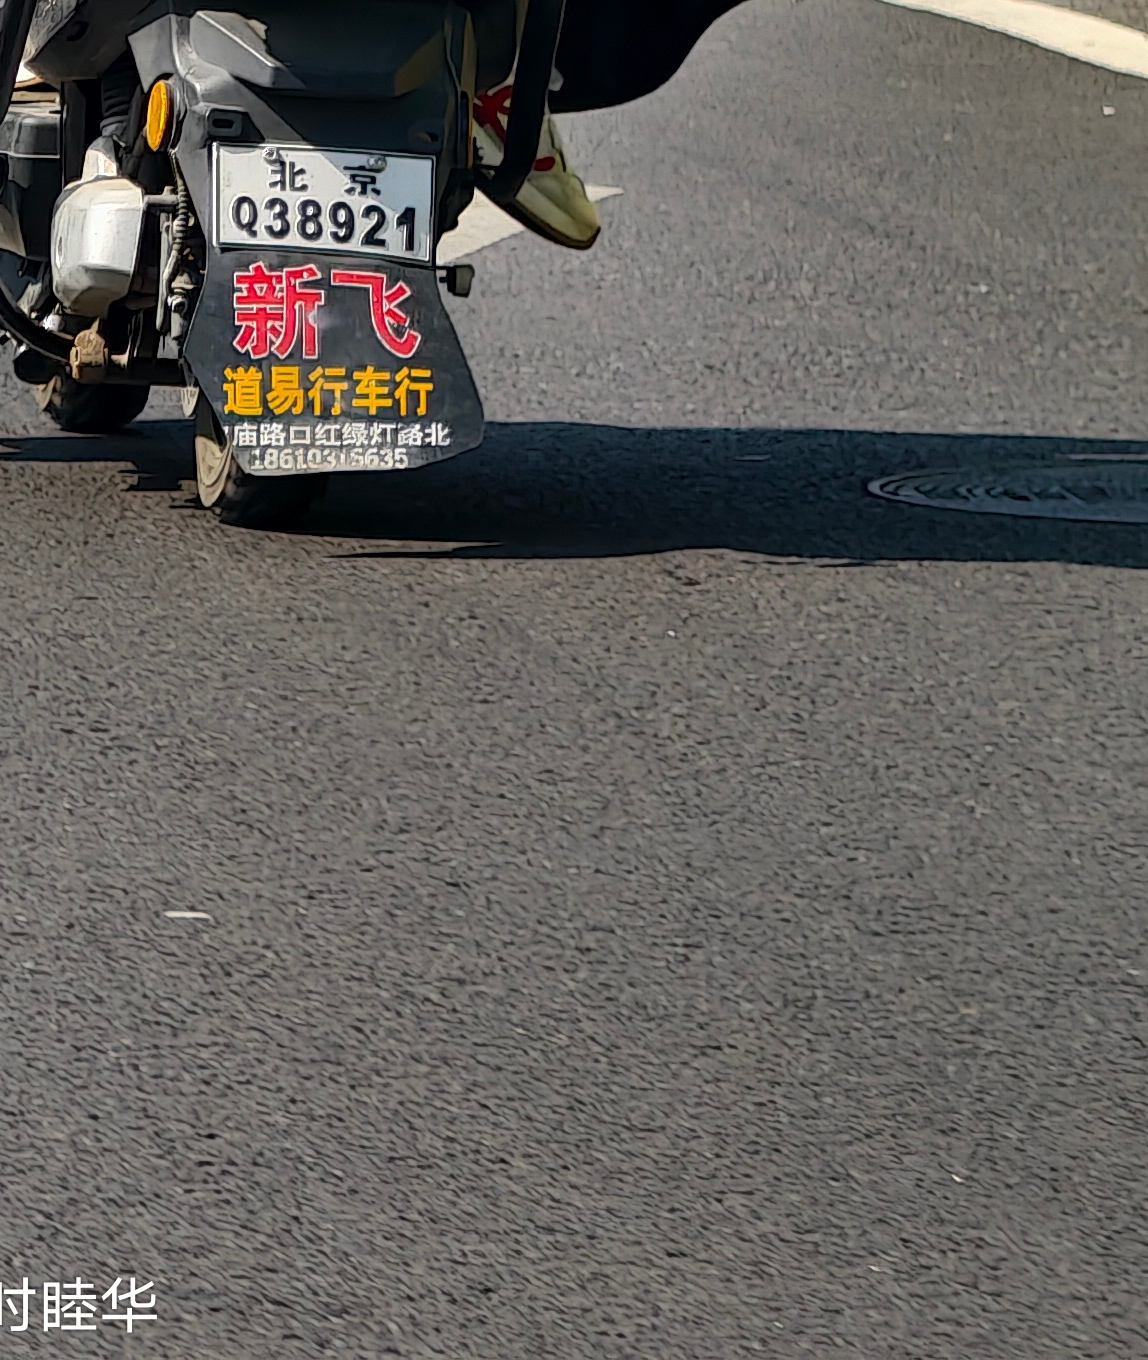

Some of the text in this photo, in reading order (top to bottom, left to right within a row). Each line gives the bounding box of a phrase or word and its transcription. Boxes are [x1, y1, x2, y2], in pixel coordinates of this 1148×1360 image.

[268, 160, 381, 197] 北京
[231, 195, 416, 252] Q38921
[232, 261, 422, 360] 新飞
[222, 365, 435, 417] 道易行车行
[225, 422, 452, 448] 庙路口红绿灯路北
